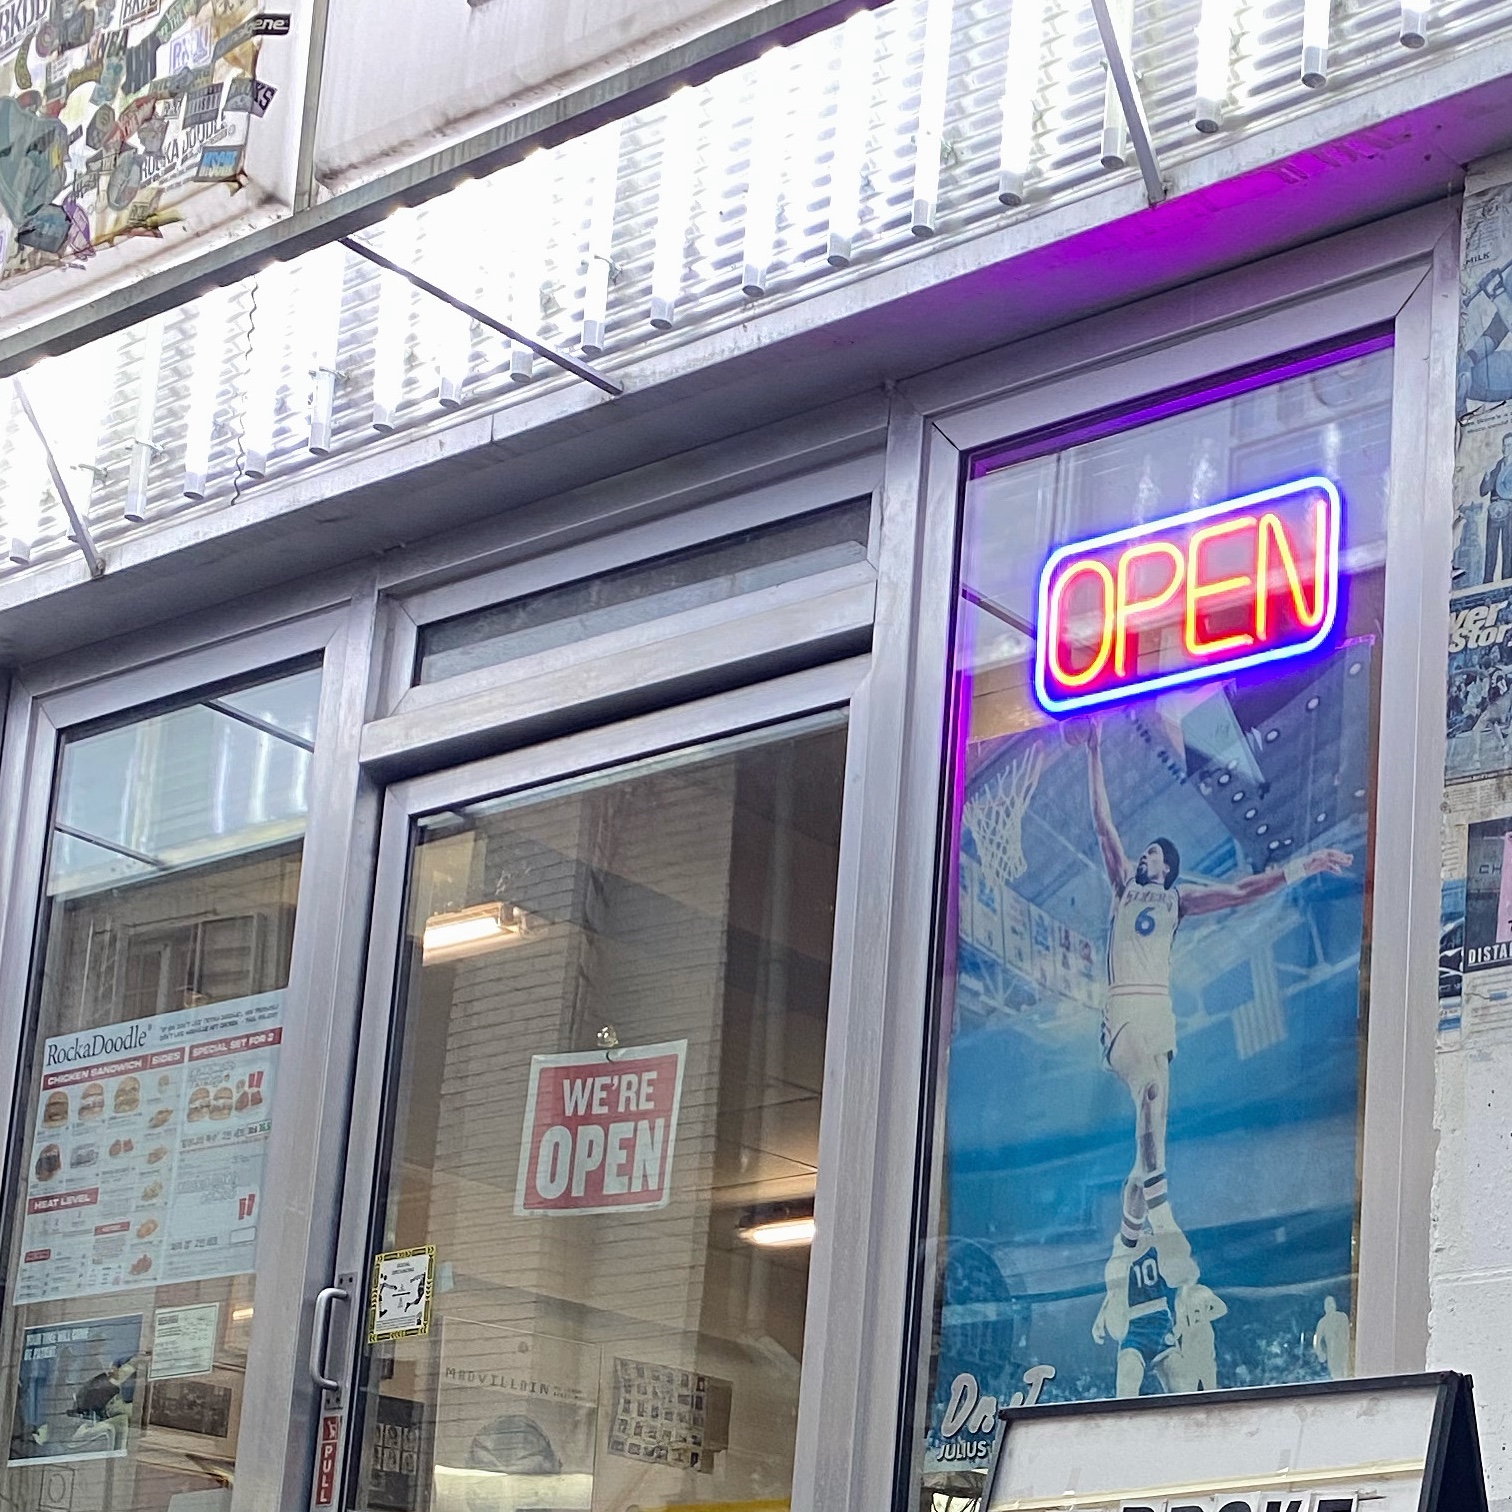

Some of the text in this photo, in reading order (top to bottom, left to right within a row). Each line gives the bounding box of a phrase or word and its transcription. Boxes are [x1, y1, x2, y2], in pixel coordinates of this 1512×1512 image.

[1049, 499, 1327, 687] OPEN
[1134, 906, 1156, 938] 6
[46, 1024, 148, 1067] RockaDoodle
[47, 1070, 90, 1086] CHICKEN
[91, 1059, 143, 1077] SANDWICH
[152, 1052, 181, 1065] SIDES
[230, 1038, 248, 1049] SET
[249, 1034, 267, 1045] FOR
[562, 1070, 658, 1117] WE'RE
[535, 1117, 665, 1200] OPEN
[34, 1193, 92, 1211] HEAT LEVEL
[1133, 1258, 1158, 1288] 10
[937, 1440, 987, 1461] JULIUS
[318, 1444, 334, 1503] PULL
